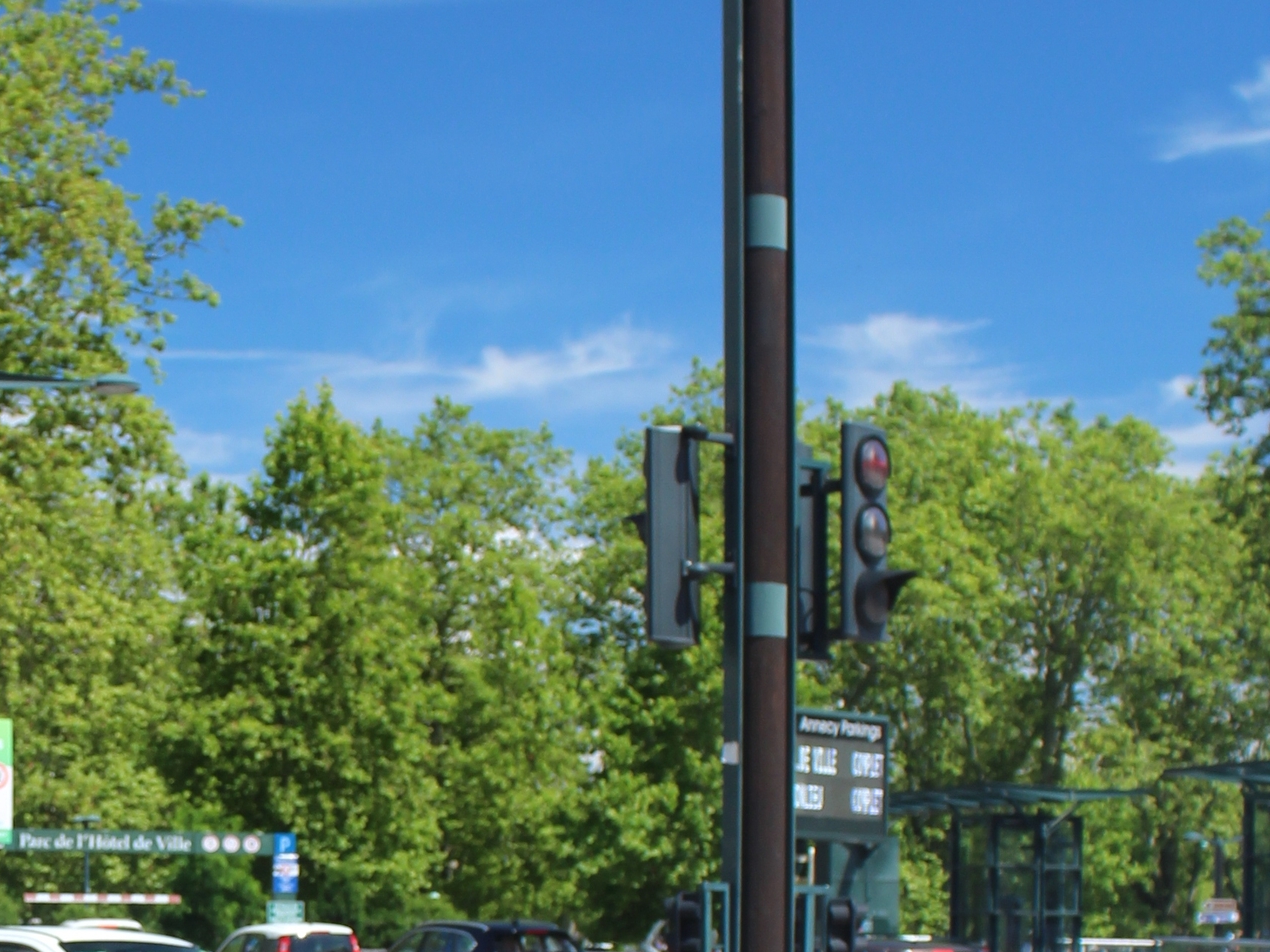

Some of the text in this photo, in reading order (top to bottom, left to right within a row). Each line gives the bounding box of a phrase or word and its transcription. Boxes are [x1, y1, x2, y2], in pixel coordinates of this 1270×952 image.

[799, 716, 882, 742] Annecy Parkings
[19, 832, 51, 849] Parc
[53, 833, 74, 849] de
[132, 834, 153, 851] de
[155, 834, 192, 852] Ville
[279, 836, 291, 852] P
